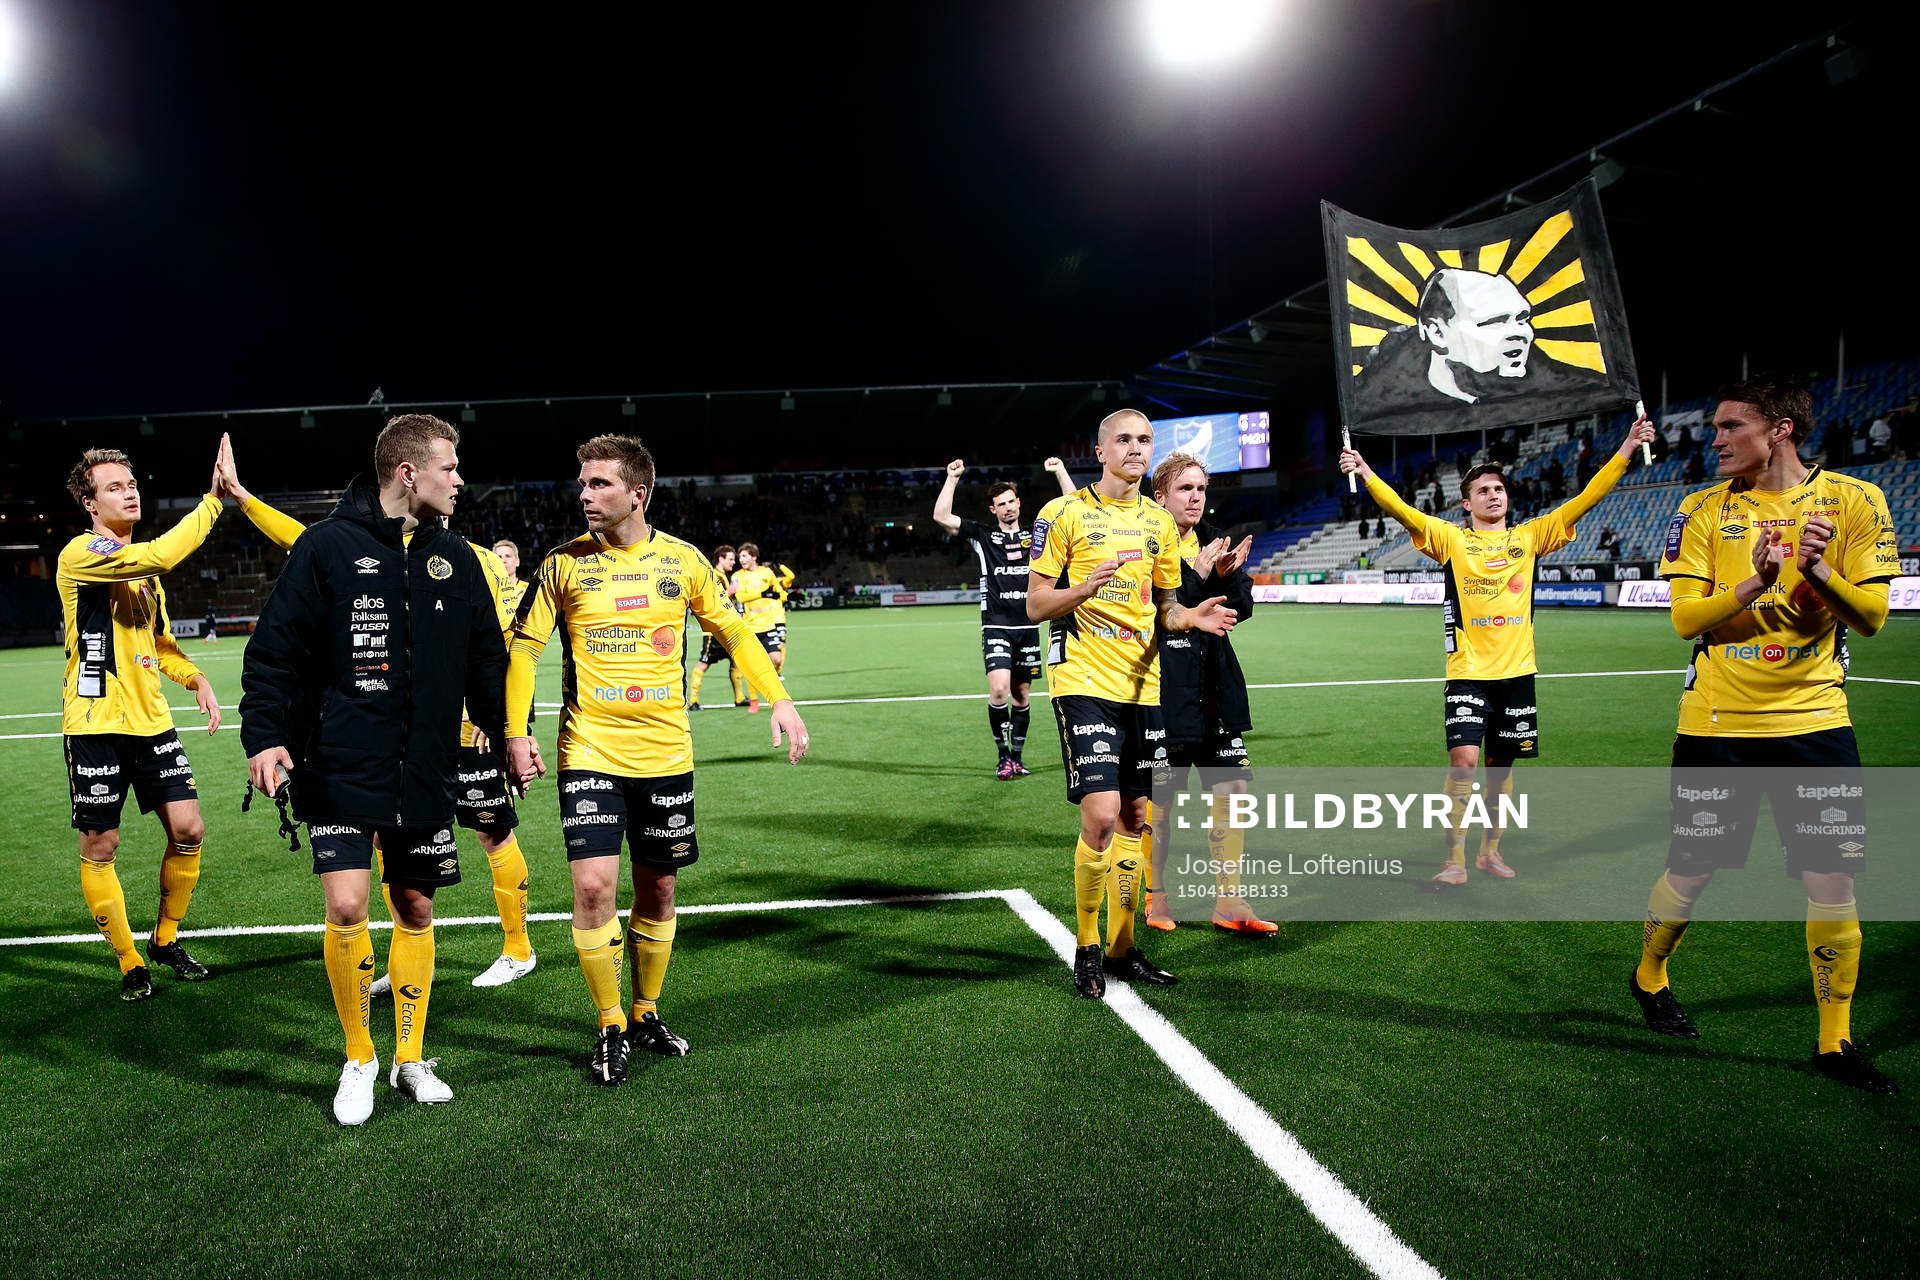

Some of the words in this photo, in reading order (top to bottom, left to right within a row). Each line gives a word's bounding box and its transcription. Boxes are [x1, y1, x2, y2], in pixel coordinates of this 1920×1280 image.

[1815, 497, 1839, 506] ellos
[1753, 519, 1796, 527] CRAMO
[578, 556, 598, 564] ellos
[660, 556, 680, 565] ellos
[578, 566, 607, 574] PULSEN
[653, 567, 682, 575] PULSEN
[994, 565, 1029, 575] PULSE
[1538, 565, 1561, 581] kvm
[1570, 565, 1596, 581] kvm
[1614, 564, 1640, 580] kvm
[1463, 576, 1504, 586] Swedbank
[353, 595, 385, 610] ellos
[434, 600, 444, 611] A
[617, 597, 647, 608] STAPLES
[351, 611, 389, 622] Folksam
[350, 622, 390, 632] PULSEN
[584, 627, 645, 639] Swedbank
[586, 641, 637, 654] Sjuhärad
[77, 764, 120, 778] tapet.se
[458, 768, 498, 784] apet.se
[564, 777, 613, 794] apet.se
[1069, 771, 1080, 789] 12
[1677, 785, 1731, 801] tapet.s
[1796, 784, 1863, 800] tapet.se
[562, 814, 618, 828] ÄRNGRINDEN
[1118, 874, 1135, 909] Ecotec
[1817, 965, 1834, 1004] Ecotec
[400, 1002, 416, 1042] Ecotec
